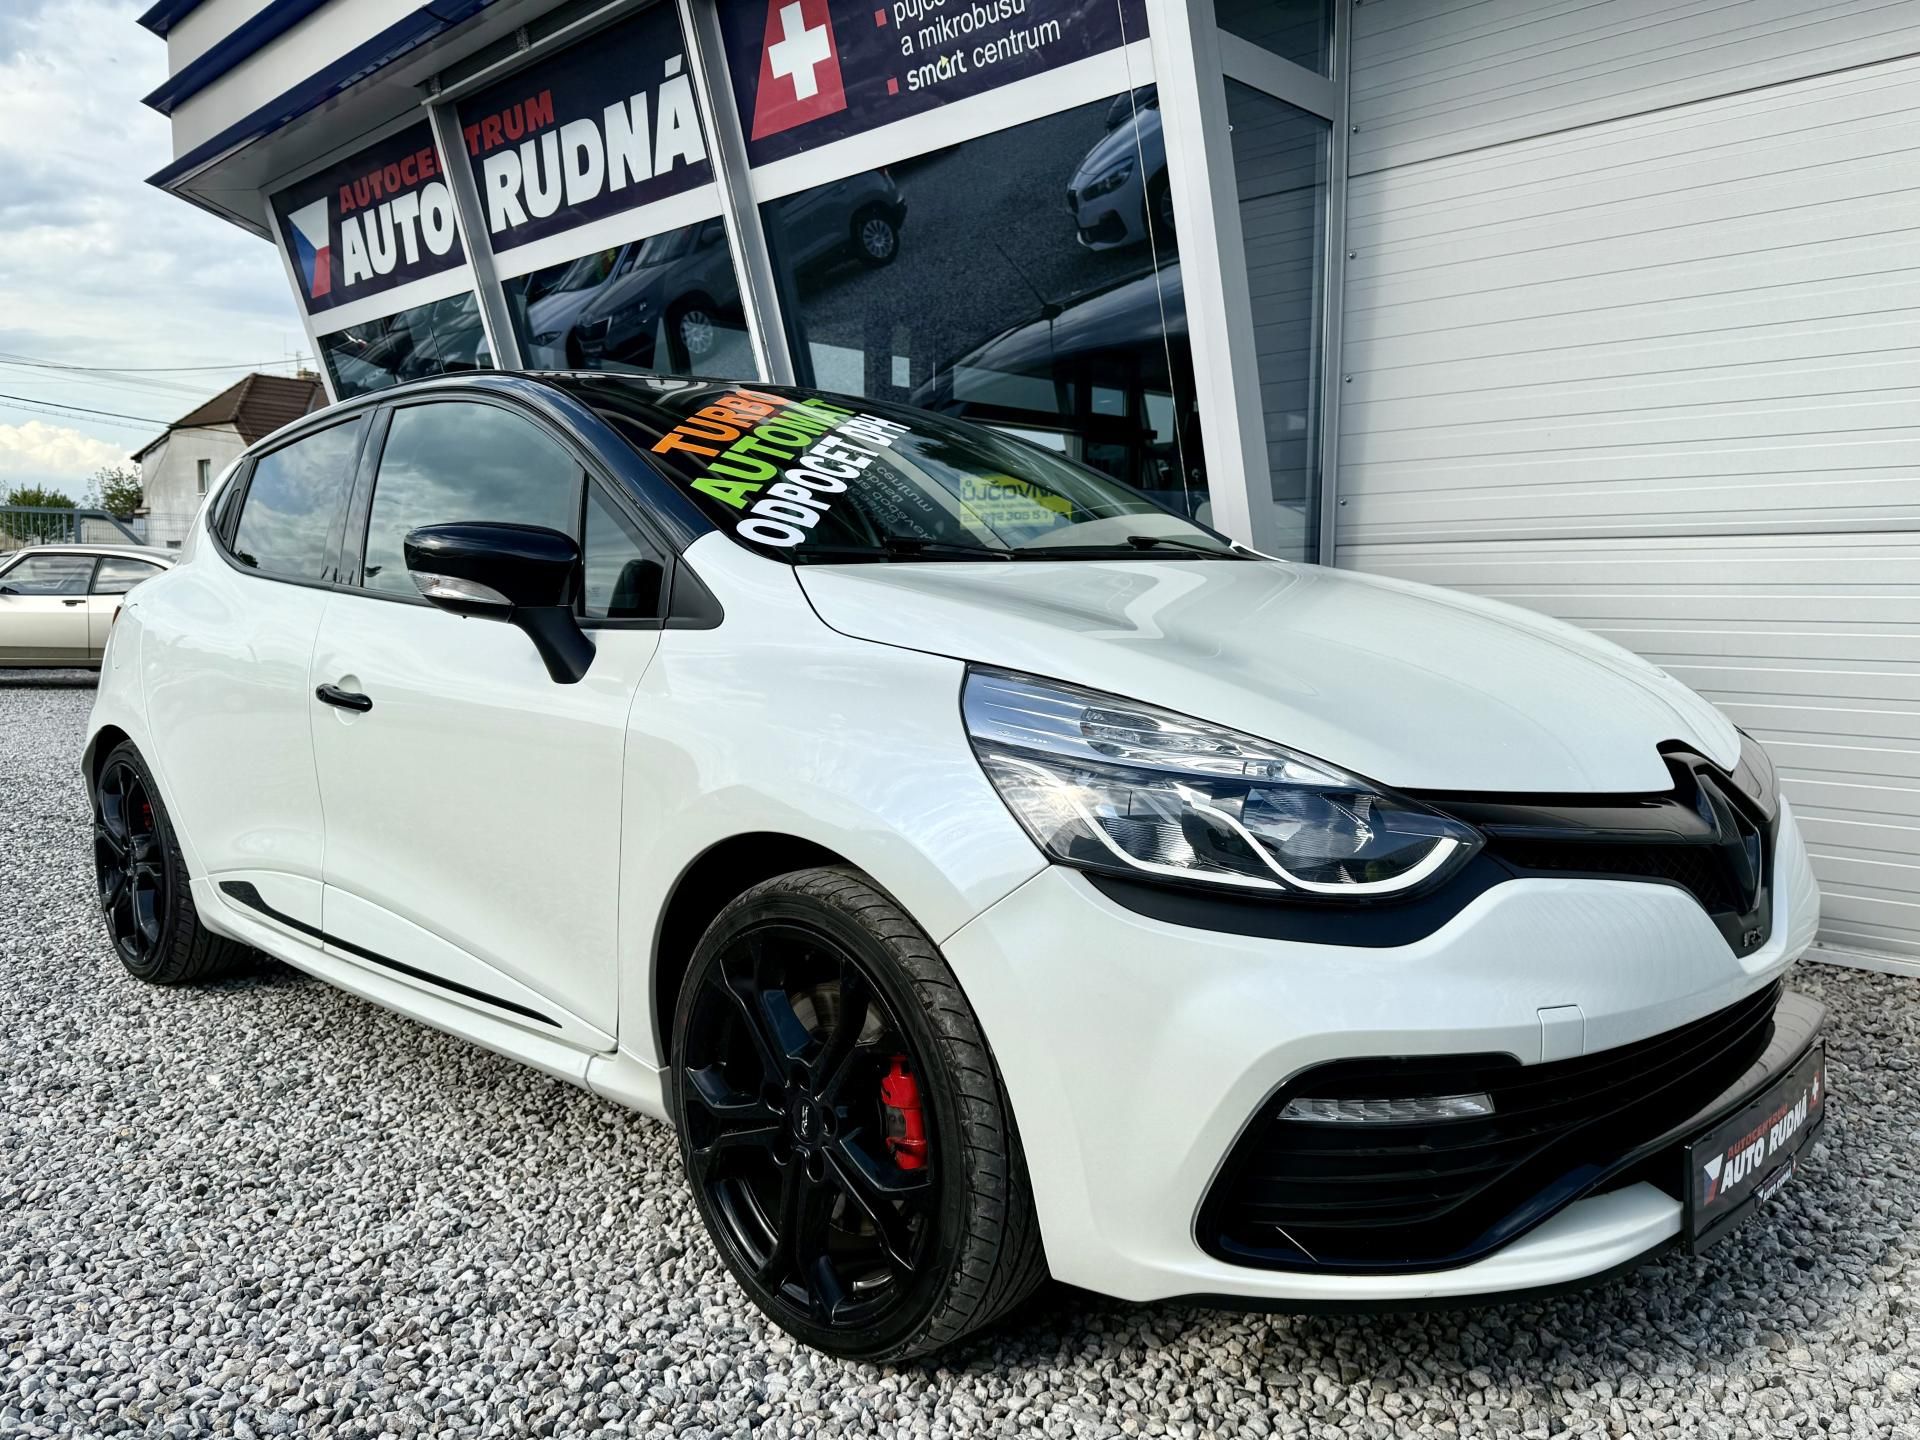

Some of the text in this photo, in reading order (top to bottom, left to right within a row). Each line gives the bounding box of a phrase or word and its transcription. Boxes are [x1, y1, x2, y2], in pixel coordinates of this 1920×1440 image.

[901, 35, 914, 56] a
[906, 19, 1061, 91] smart centrum
[339, 89, 555, 213] AUTOCETRUM
[341, 53, 707, 286] AUTO RUDNÁ
[651, 390, 790, 457] TURBO
[690, 398, 856, 509] AUTOMAT
[836, 413, 911, 447] DPH
[1720, 1137, 1765, 1194] AUTO
[1768, 1088, 1807, 1156] RUDNÁ
